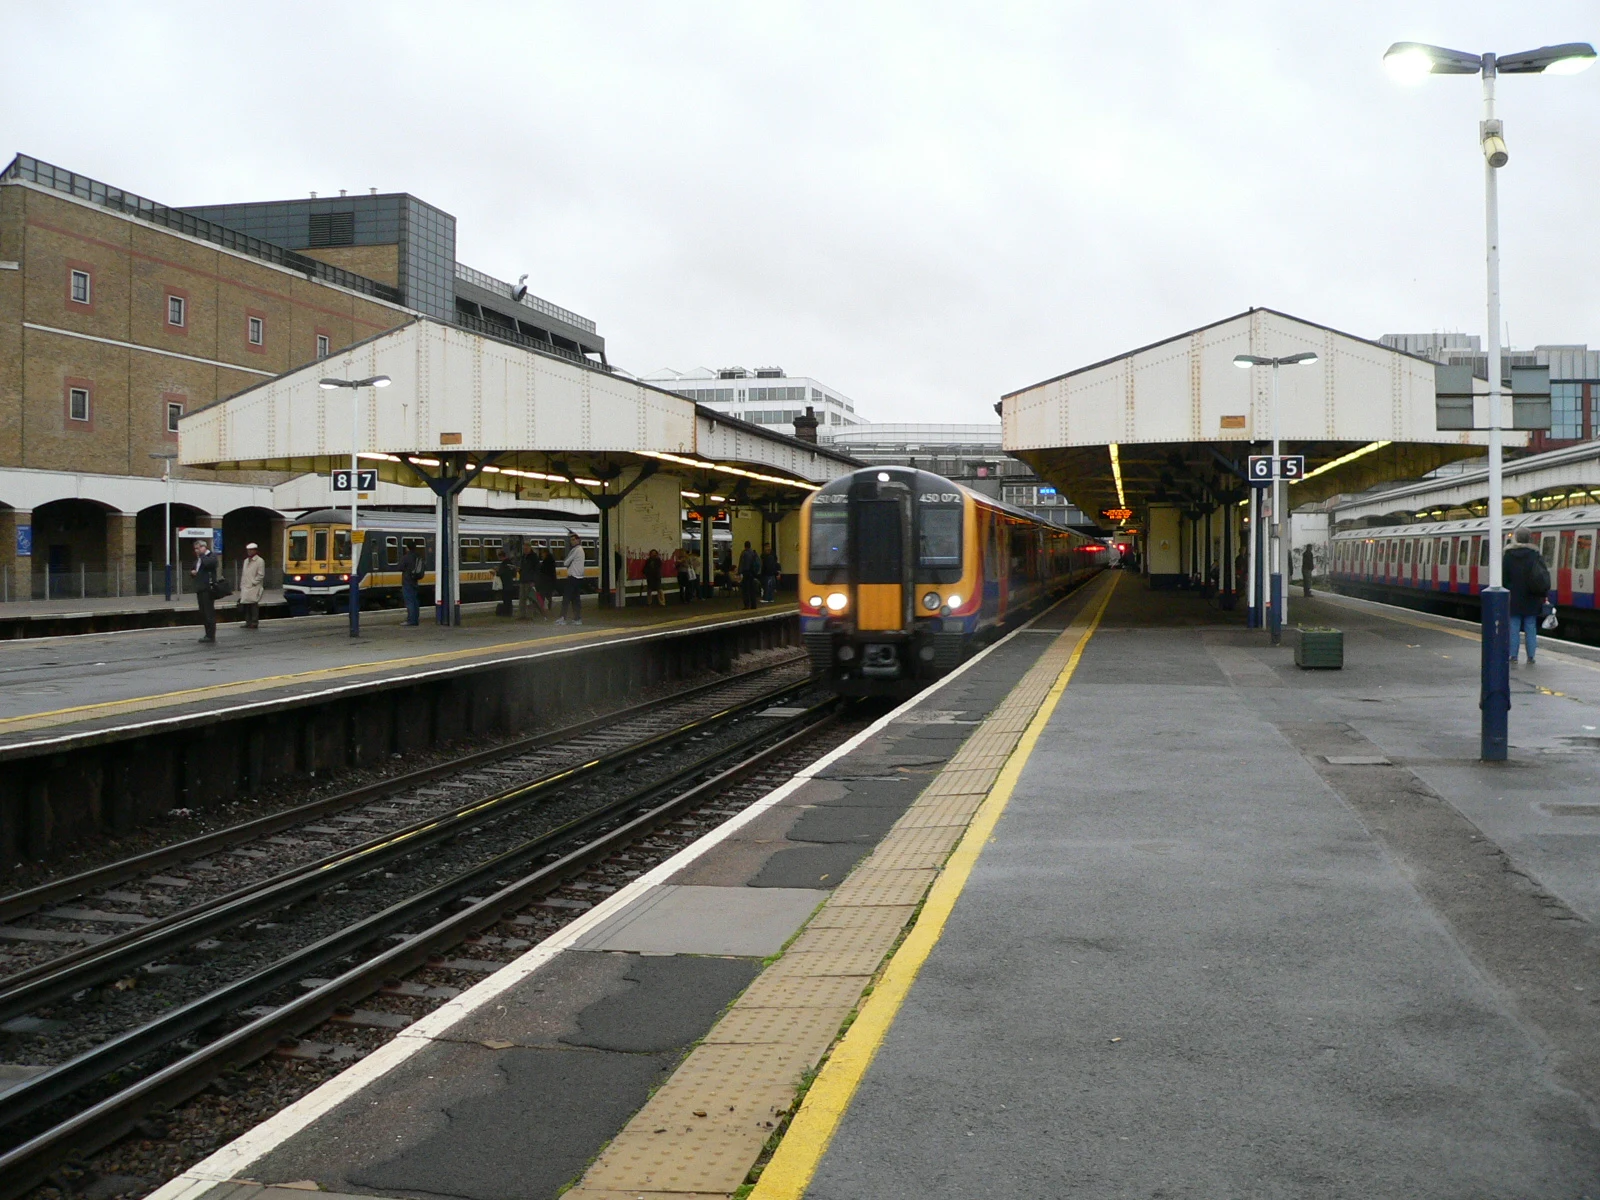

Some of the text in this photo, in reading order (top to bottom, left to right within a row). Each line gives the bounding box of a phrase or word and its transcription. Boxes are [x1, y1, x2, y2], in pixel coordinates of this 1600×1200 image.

[1255, 460, 1267, 476] 6
[1286, 460, 1297, 475] 5
[337, 474, 347, 488] 8
[362, 474, 372, 488] 7
[919, 493, 960, 503] 450 072
